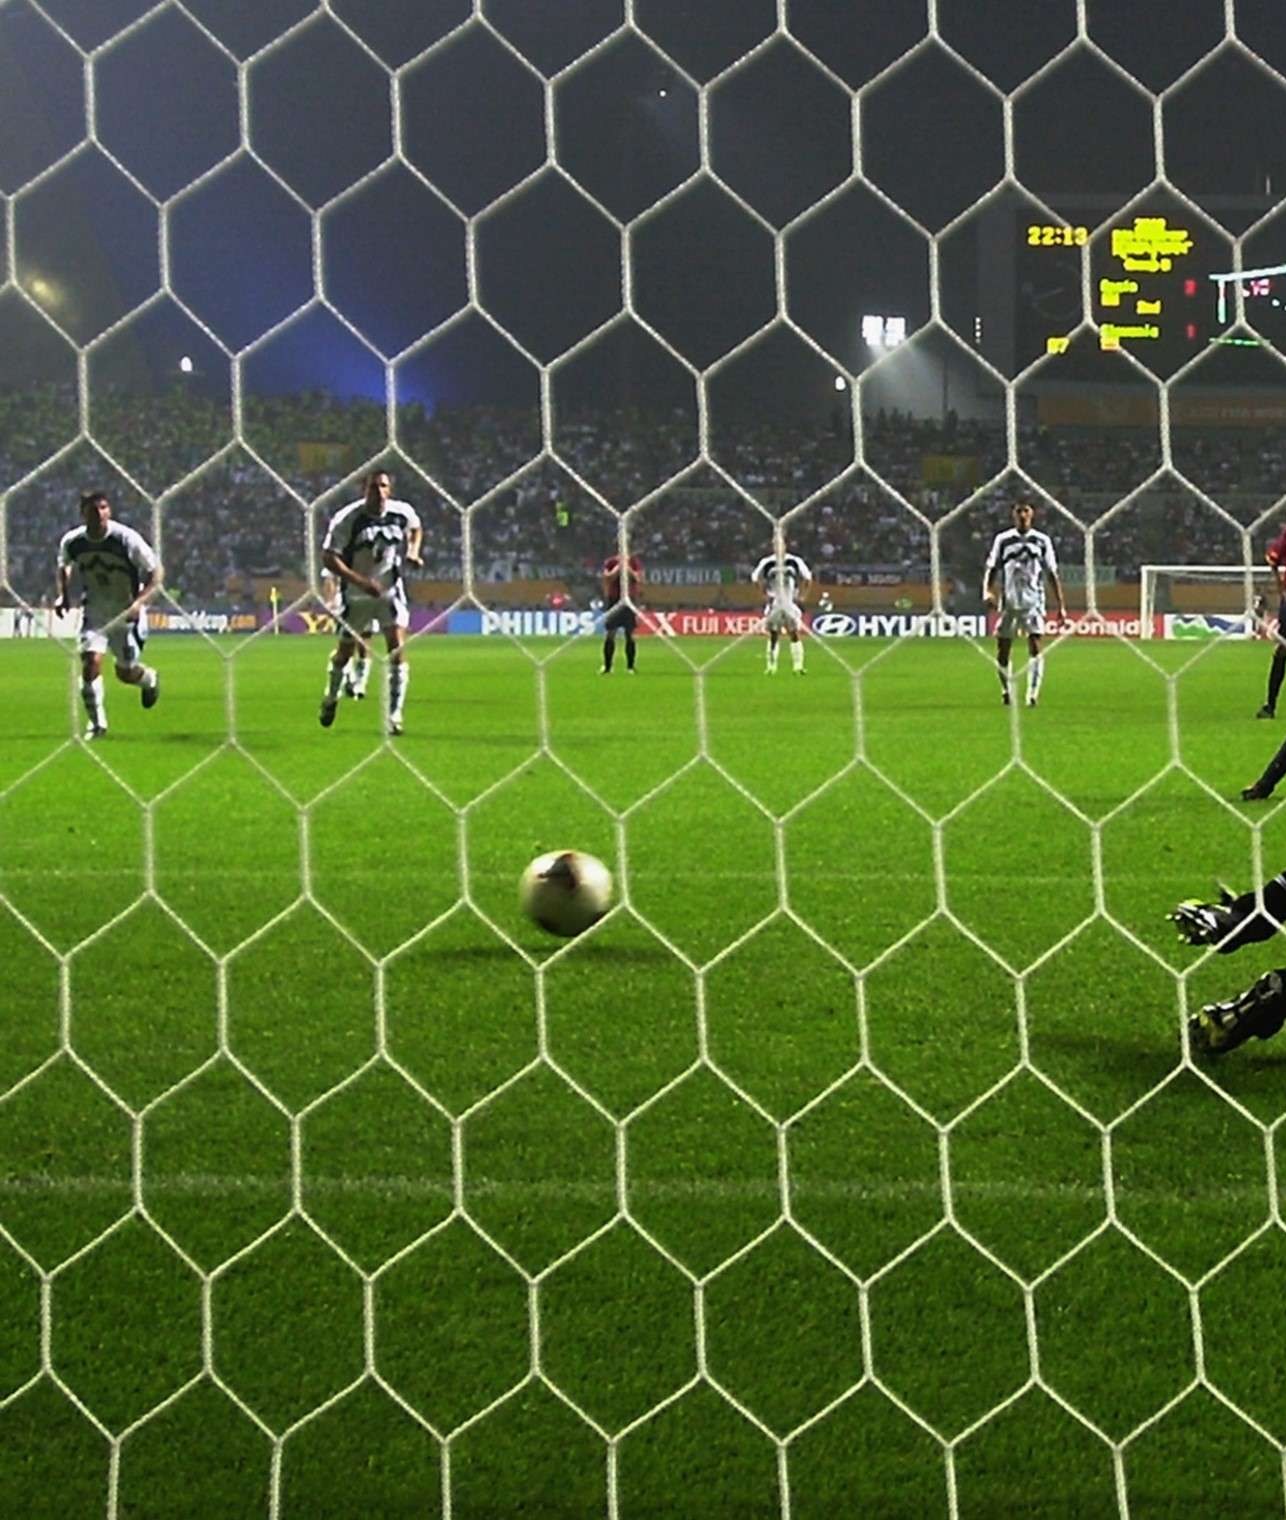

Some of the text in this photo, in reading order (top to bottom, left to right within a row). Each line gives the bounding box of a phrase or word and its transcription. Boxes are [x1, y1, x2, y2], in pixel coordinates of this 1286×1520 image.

[480, 612, 595, 636] PHILIPS
[682, 615, 719, 634] FUJI
[724, 615, 768, 634] XER
[858, 615, 985, 636] HYUNDAI
[1044, 619, 1156, 635] cDonald
